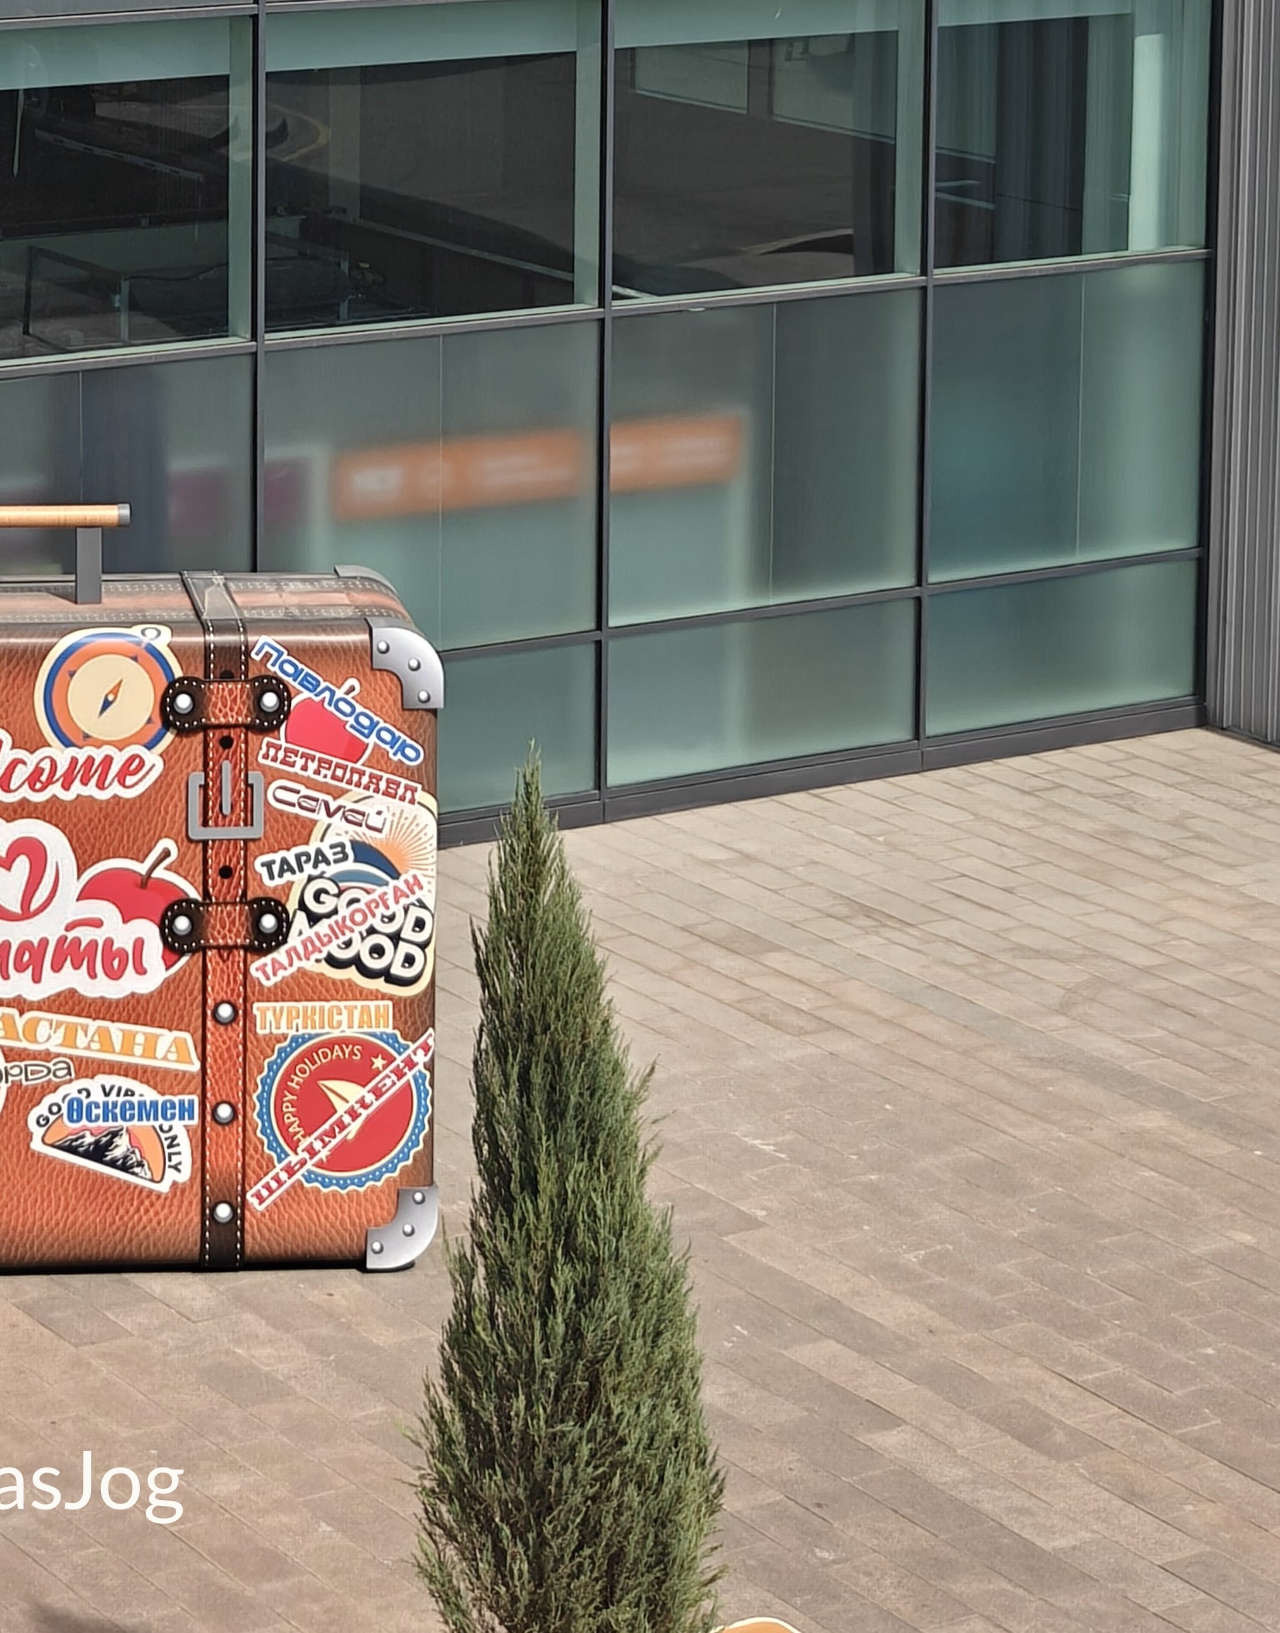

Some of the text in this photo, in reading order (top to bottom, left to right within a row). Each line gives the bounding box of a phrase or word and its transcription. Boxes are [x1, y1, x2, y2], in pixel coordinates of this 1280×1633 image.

[260, 841, 350, 882] ТАРАЗ
[66, 1096, 196, 1124] Өскемен
[281, 1043, 363, 1147] HAPPY HOLIDAYS
